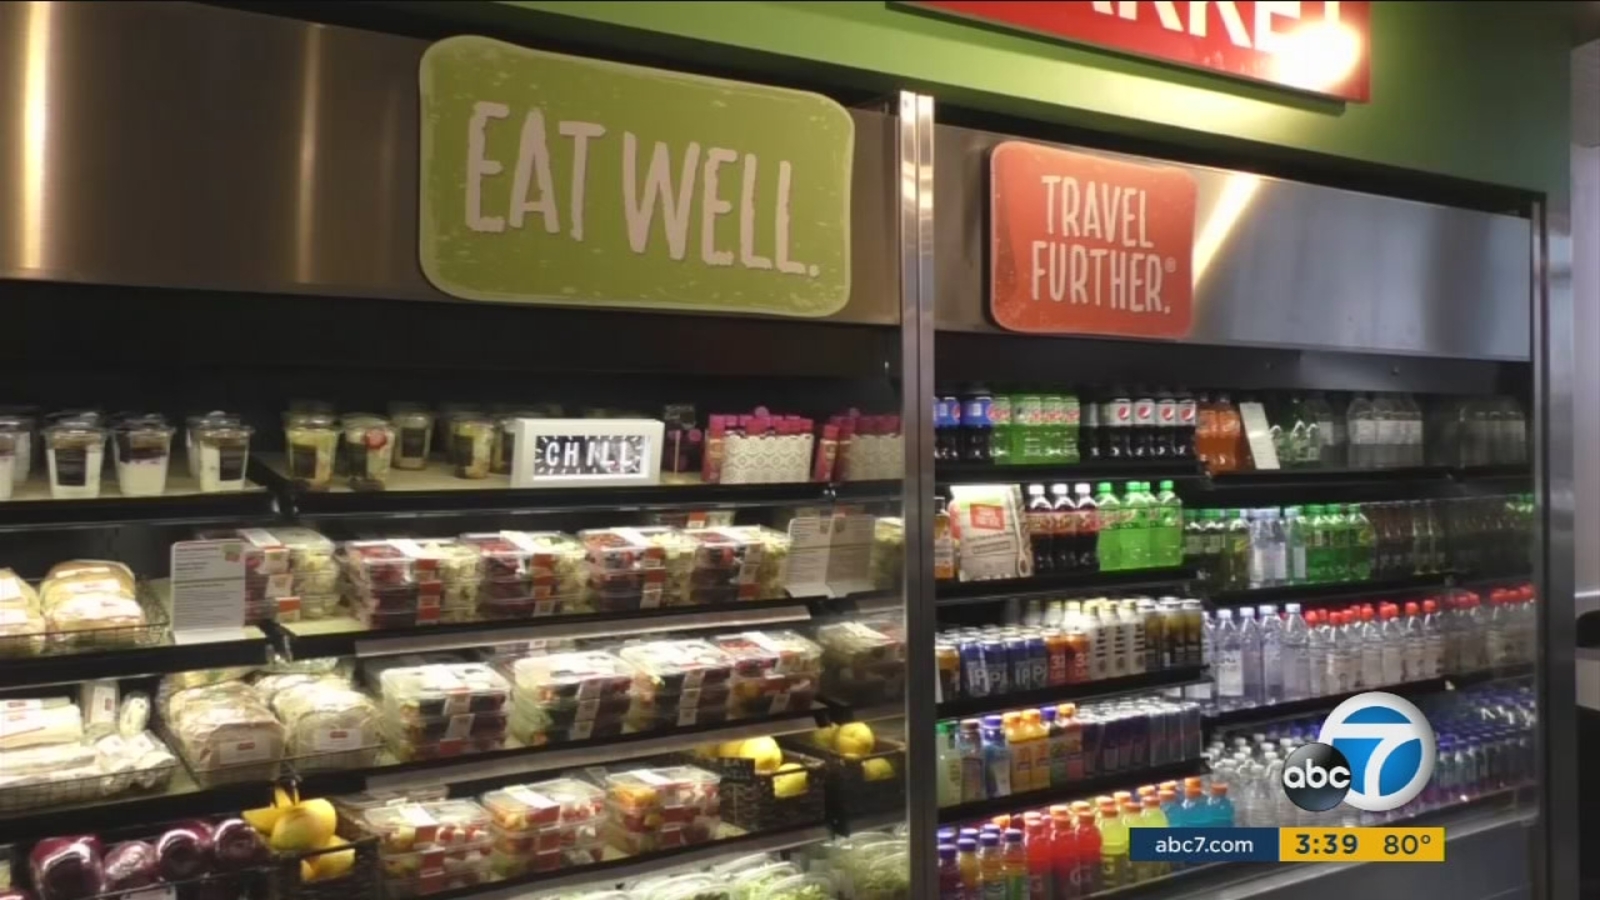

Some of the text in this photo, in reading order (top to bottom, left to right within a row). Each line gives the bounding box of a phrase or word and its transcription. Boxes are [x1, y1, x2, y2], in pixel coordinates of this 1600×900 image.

[465, 101, 820, 277] EAT WELL.
[1041, 175, 1154, 248] TRAVEL
[545, 441, 633, 467] CHILL
